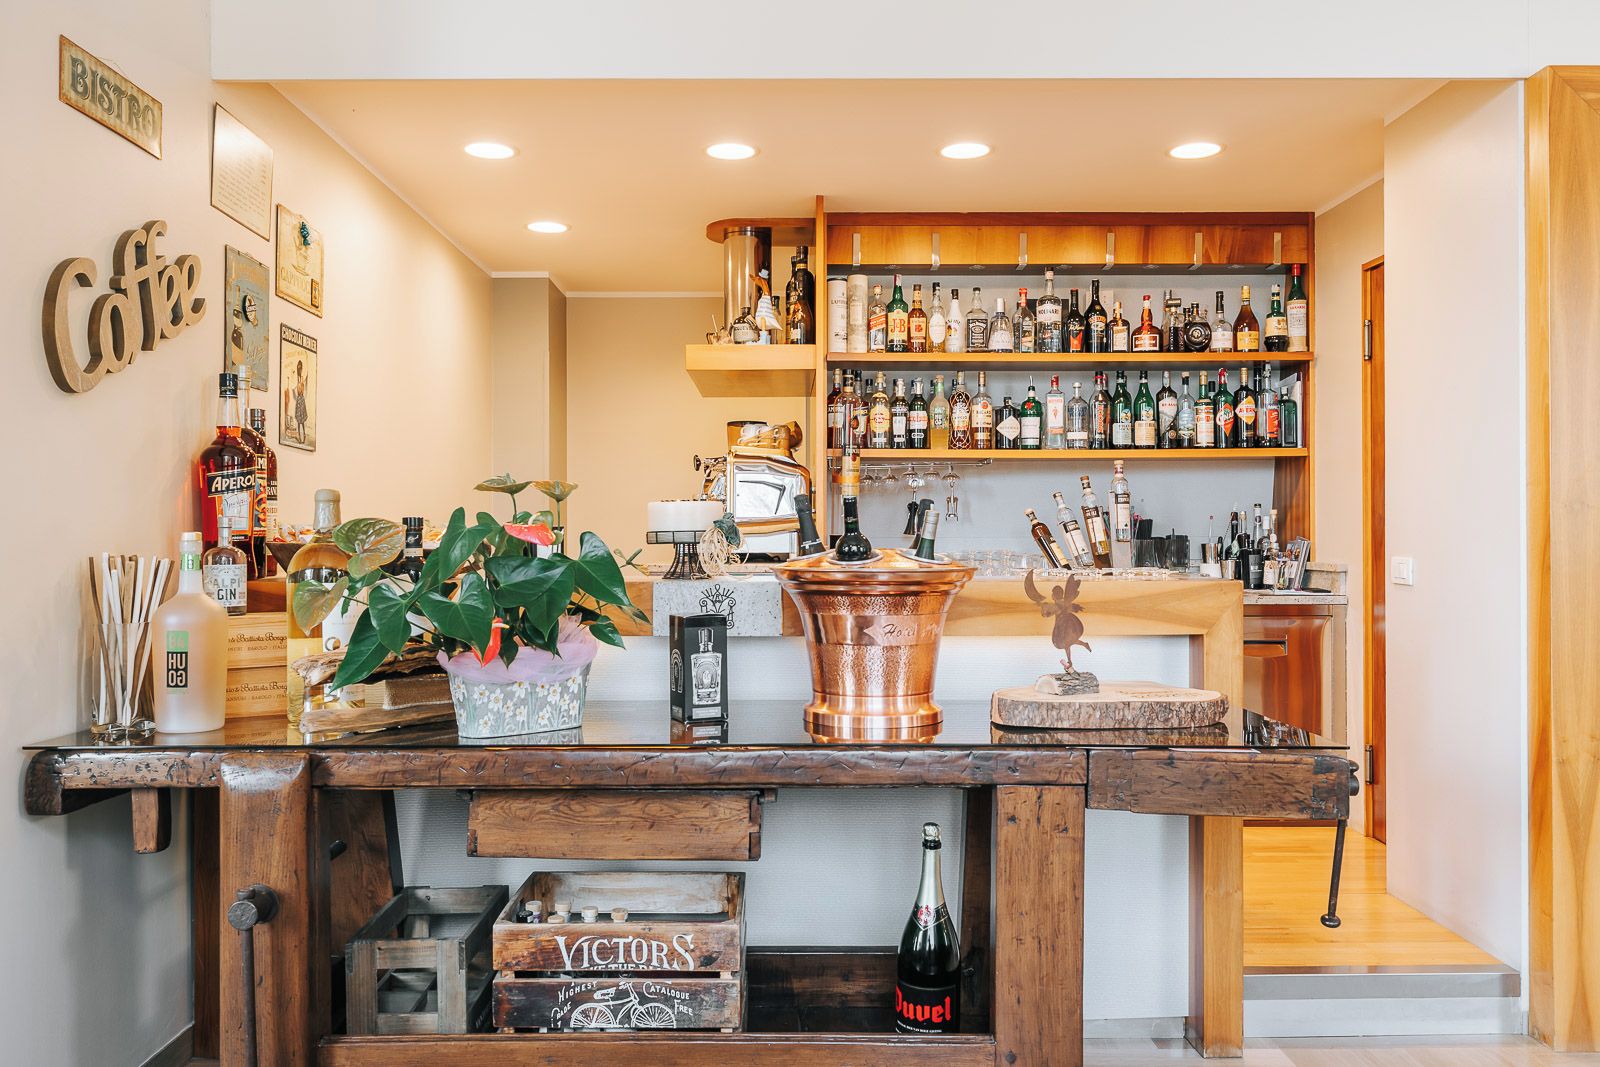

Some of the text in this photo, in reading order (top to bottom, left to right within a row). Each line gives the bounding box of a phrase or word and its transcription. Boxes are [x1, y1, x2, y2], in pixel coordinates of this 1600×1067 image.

[69, 53, 156, 139] BISTRO
[42, 219, 207, 394] Coffee
[211, 473, 256, 493] APEROL
[217, 588, 237, 601] GIN
[168, 653, 186, 669] HU
[553, 934, 695, 971] VICTORS
[558, 980, 598, 1006] HIGHEST
[642, 980, 690, 1000] CATALOGUE
[673, 999, 693, 1016] FREE
[896, 985, 952, 1024] Duvel
